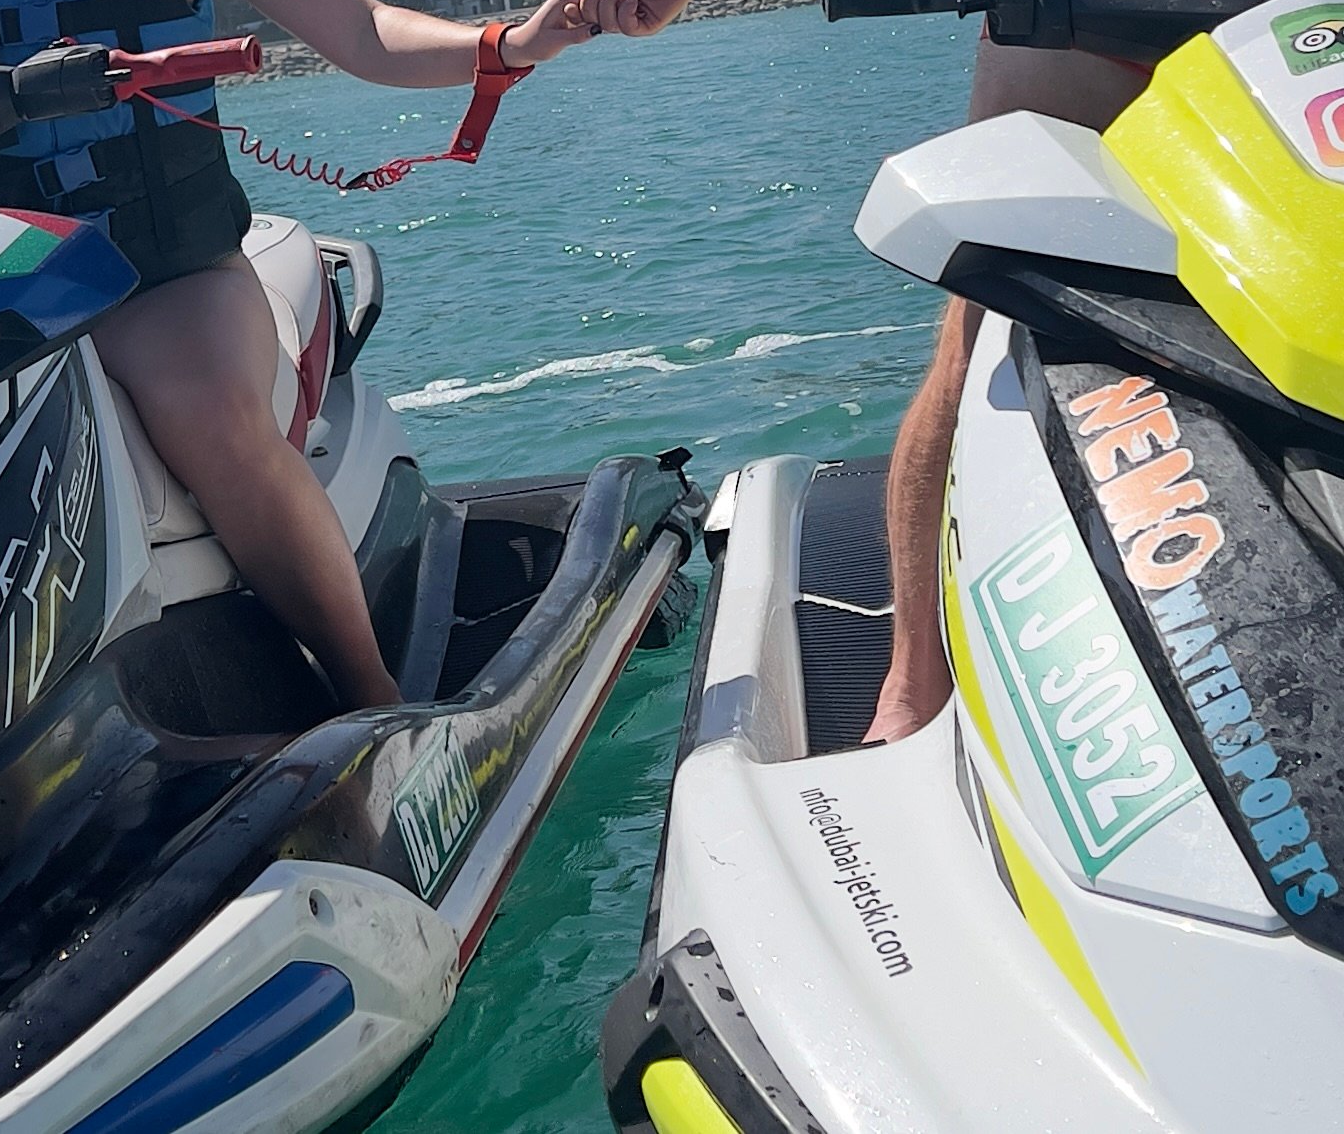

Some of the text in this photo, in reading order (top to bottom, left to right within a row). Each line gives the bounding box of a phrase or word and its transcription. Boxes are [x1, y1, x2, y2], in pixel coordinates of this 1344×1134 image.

[1039, 634, 1177, 831] 3052
[1068, 376, 1340, 917] NEMO WATERSPORTS
[799, 787, 914, 978] info@dubai-jetski.com
